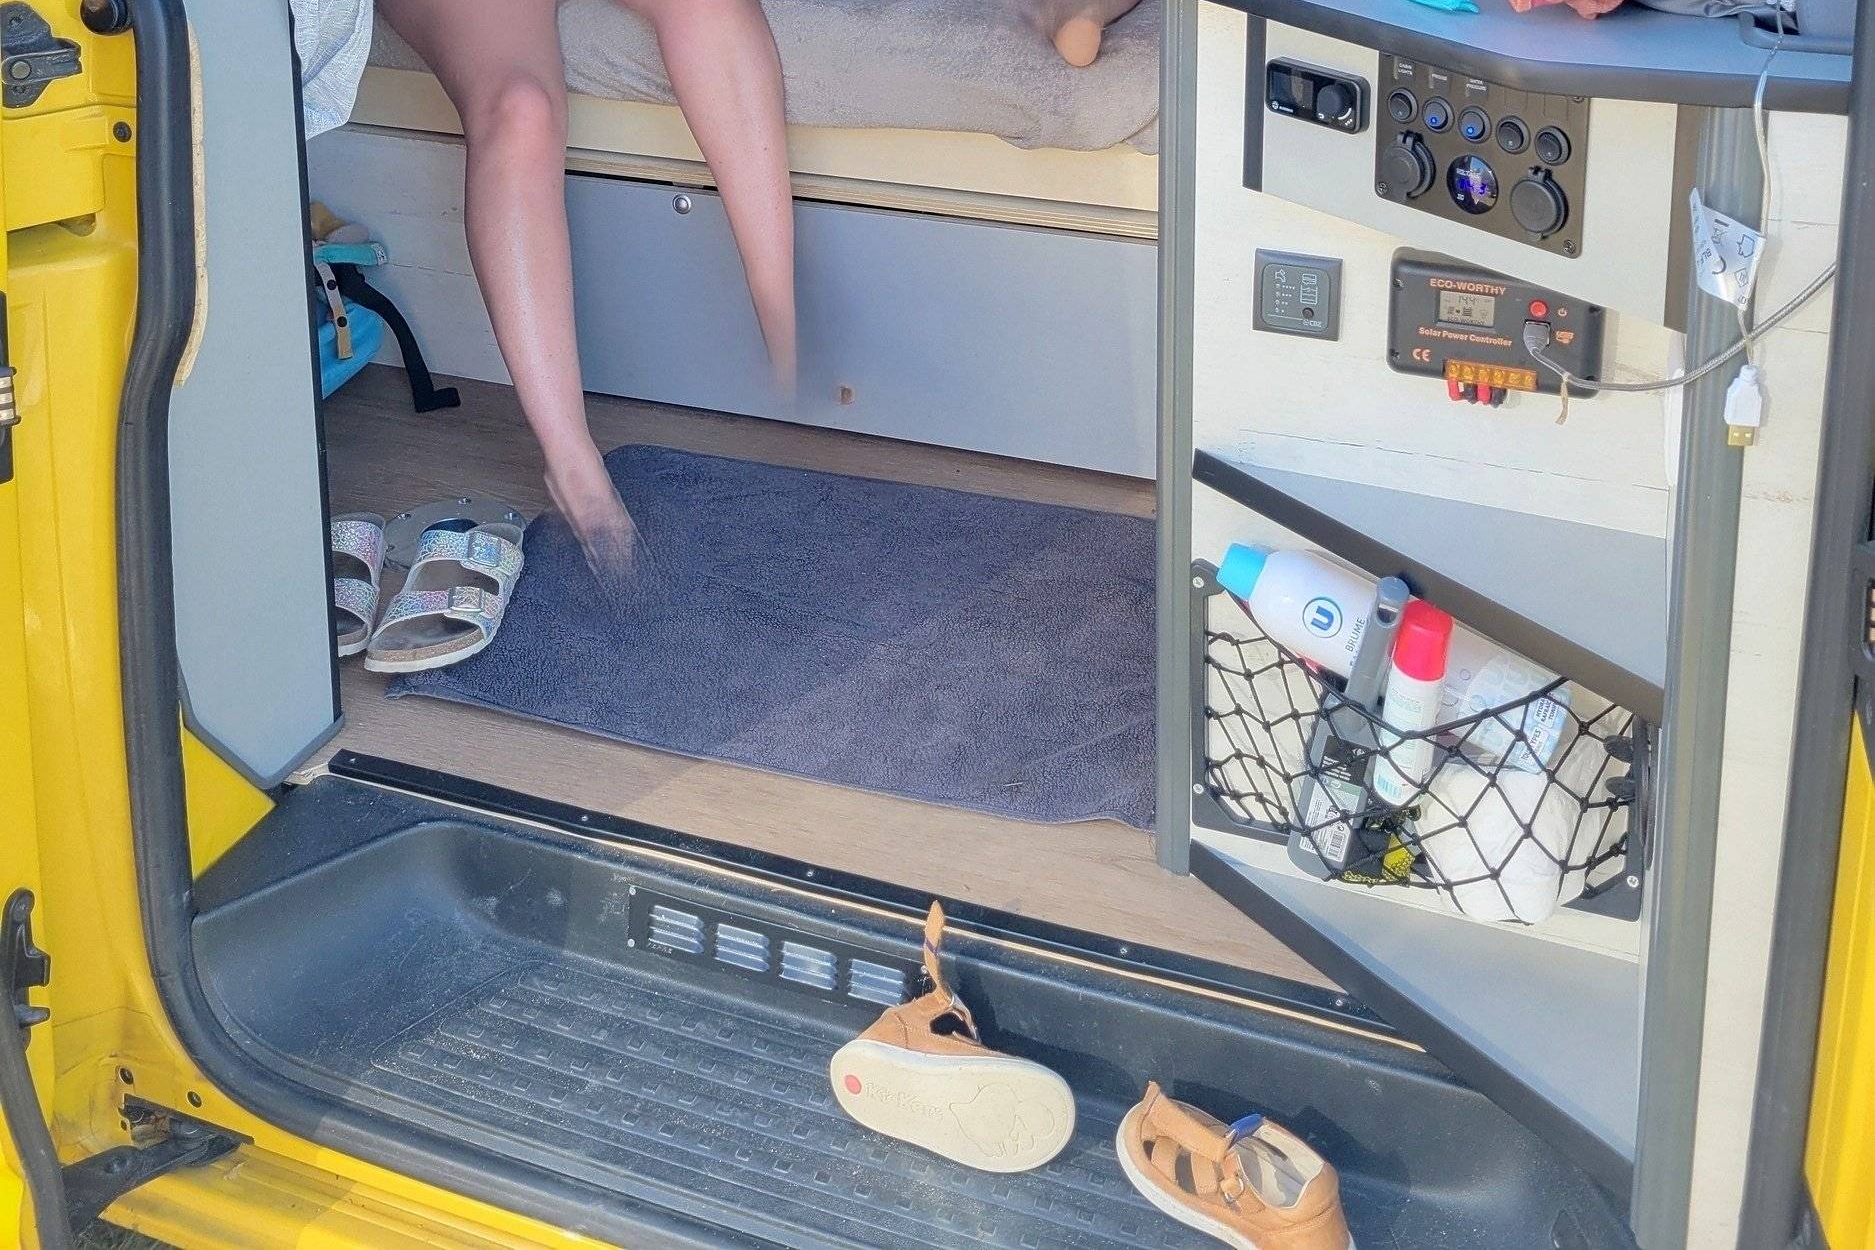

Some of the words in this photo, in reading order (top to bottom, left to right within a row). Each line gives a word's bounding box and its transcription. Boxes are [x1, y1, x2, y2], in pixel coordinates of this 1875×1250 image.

[1429, 278, 1507, 295] ECO-WORTHY
[1418, 327, 1441, 338] Solar
[1442, 330, 1469, 341] Power
[1469, 334, 1513, 347] Controller
[1310, 605, 1335, 631] U
[1344, 617, 1366, 653] BRUME
